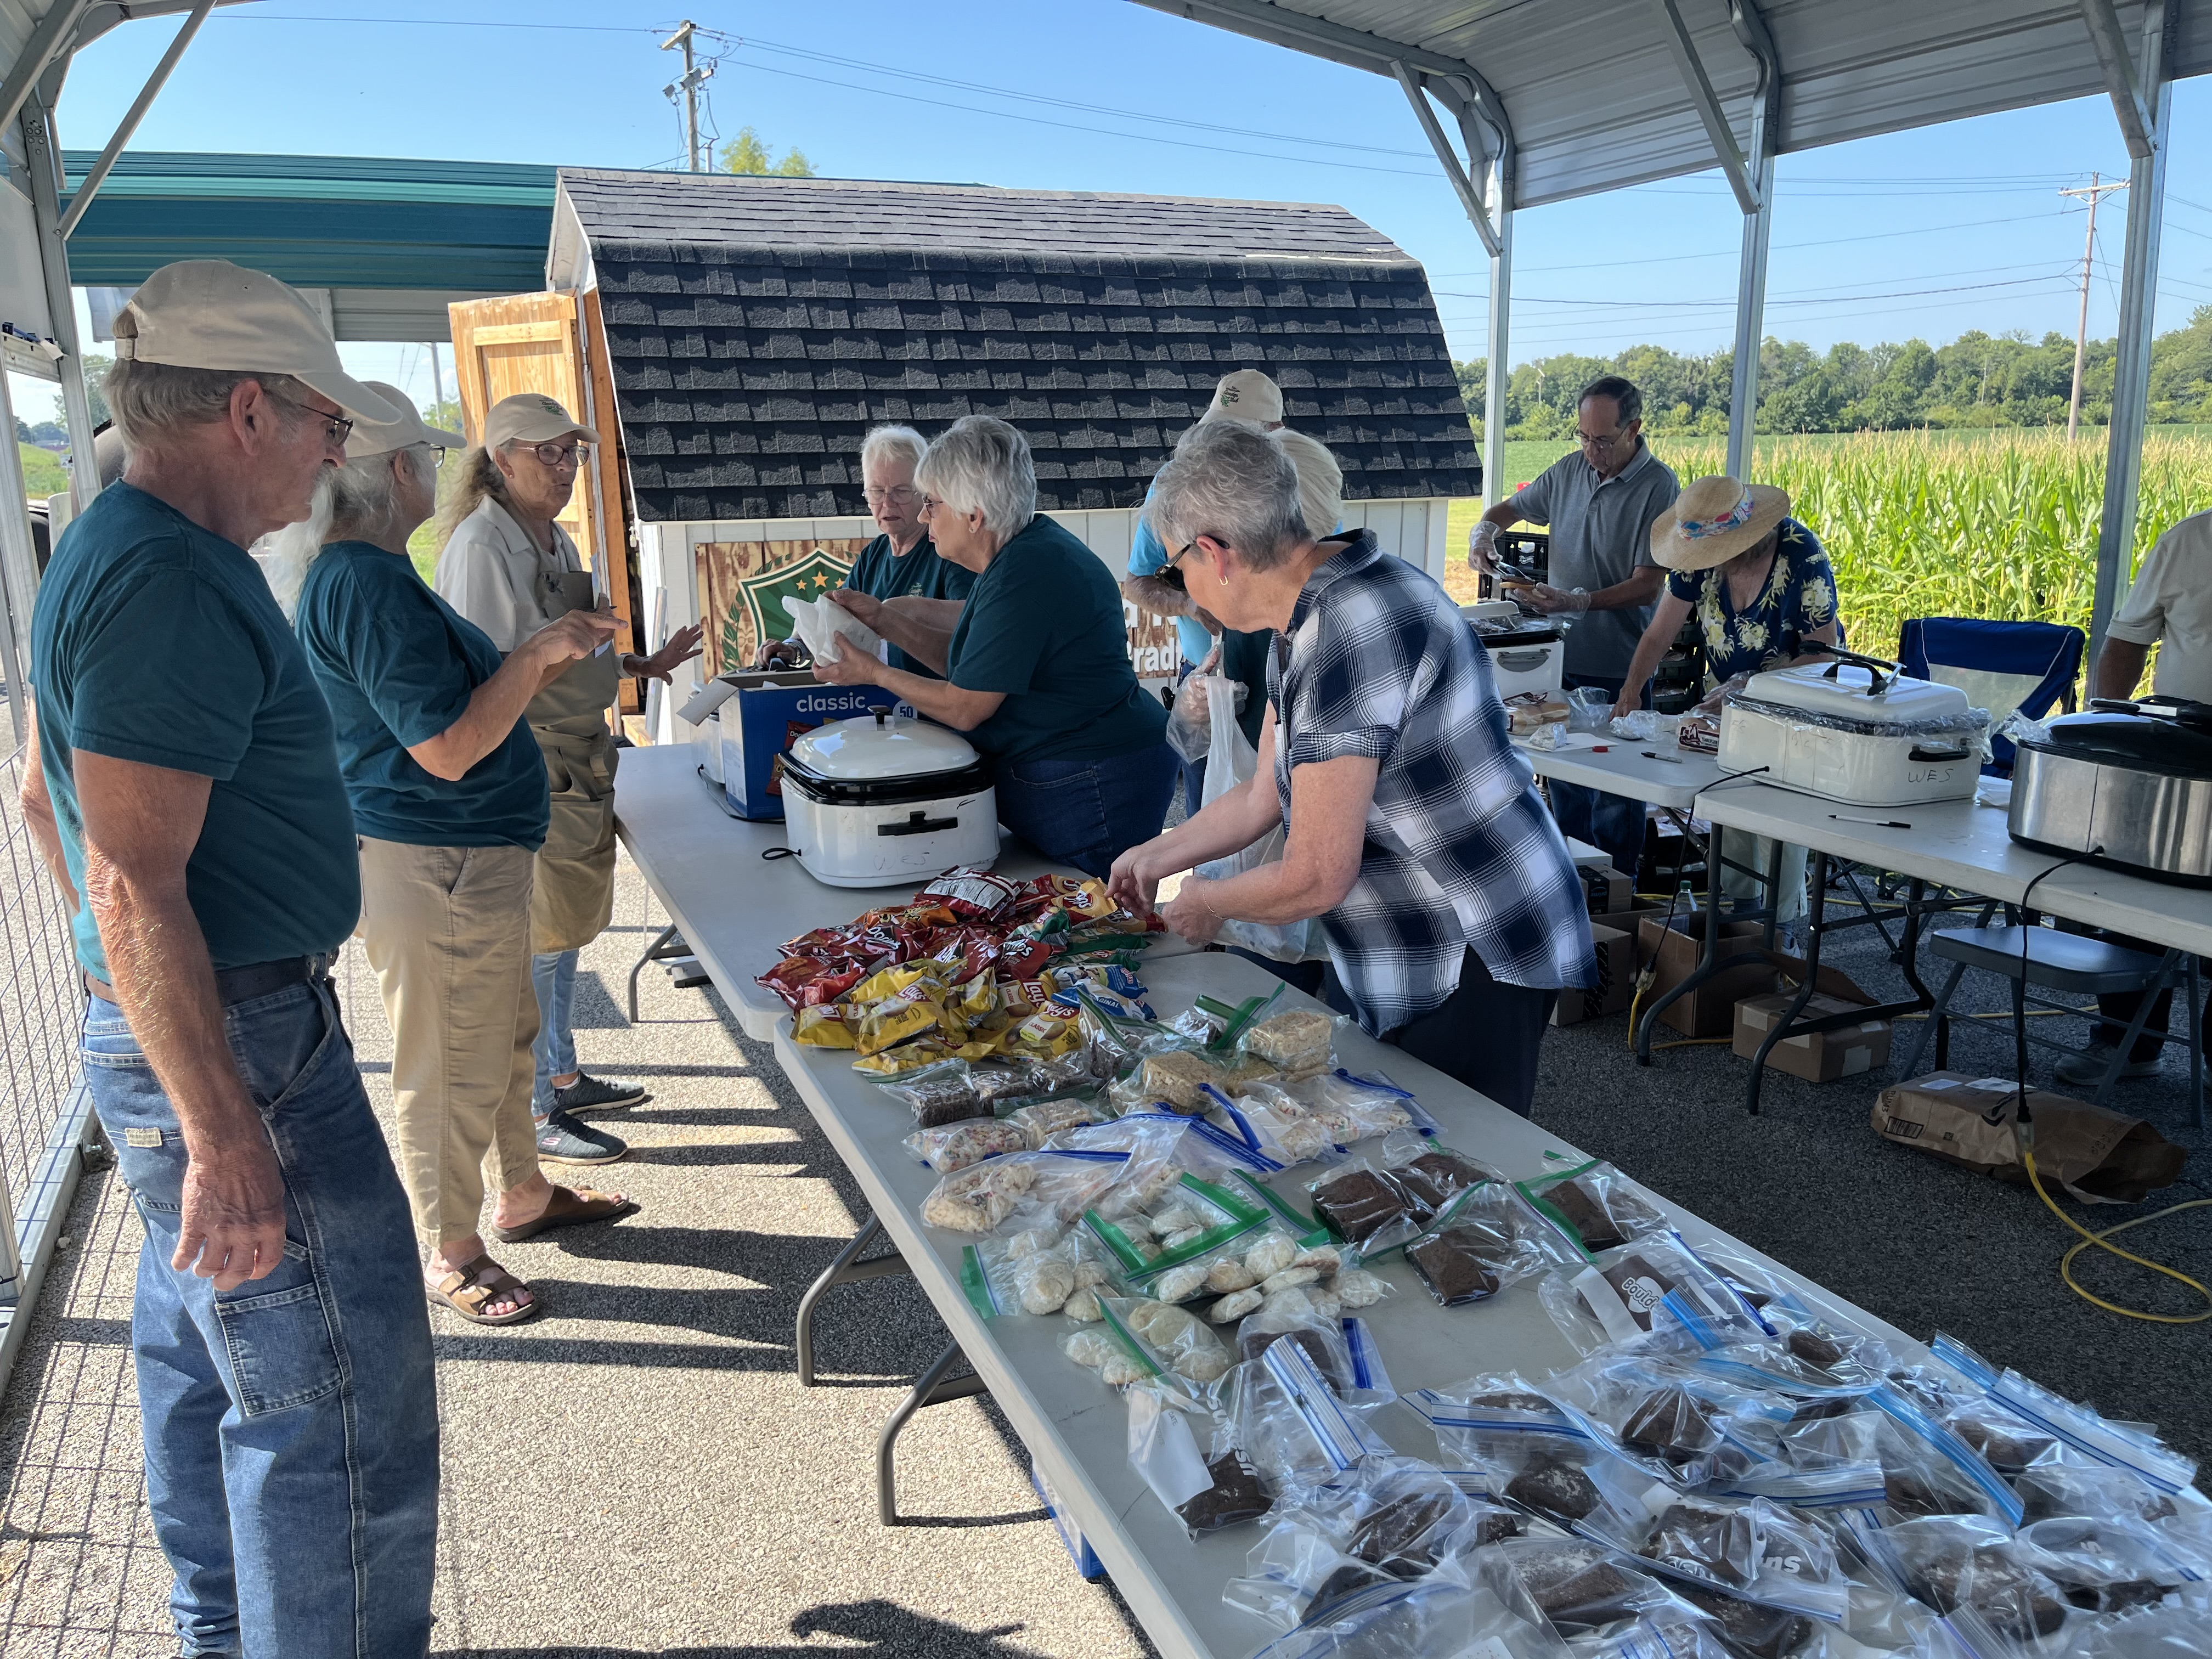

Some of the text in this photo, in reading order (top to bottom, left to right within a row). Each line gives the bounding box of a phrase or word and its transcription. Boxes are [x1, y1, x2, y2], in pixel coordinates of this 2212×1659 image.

[796, 692, 866, 713] classic
[900, 706, 913, 718] 50
[1908, 769, 1954, 782] WES
[1006, 988, 1015, 1004] CLASSIC
[1097, 996, 1119, 1008] GINAL
[1029, 1022, 1047, 1034] CLASSIC
[1168, 1410, 1178, 1427] DATE
